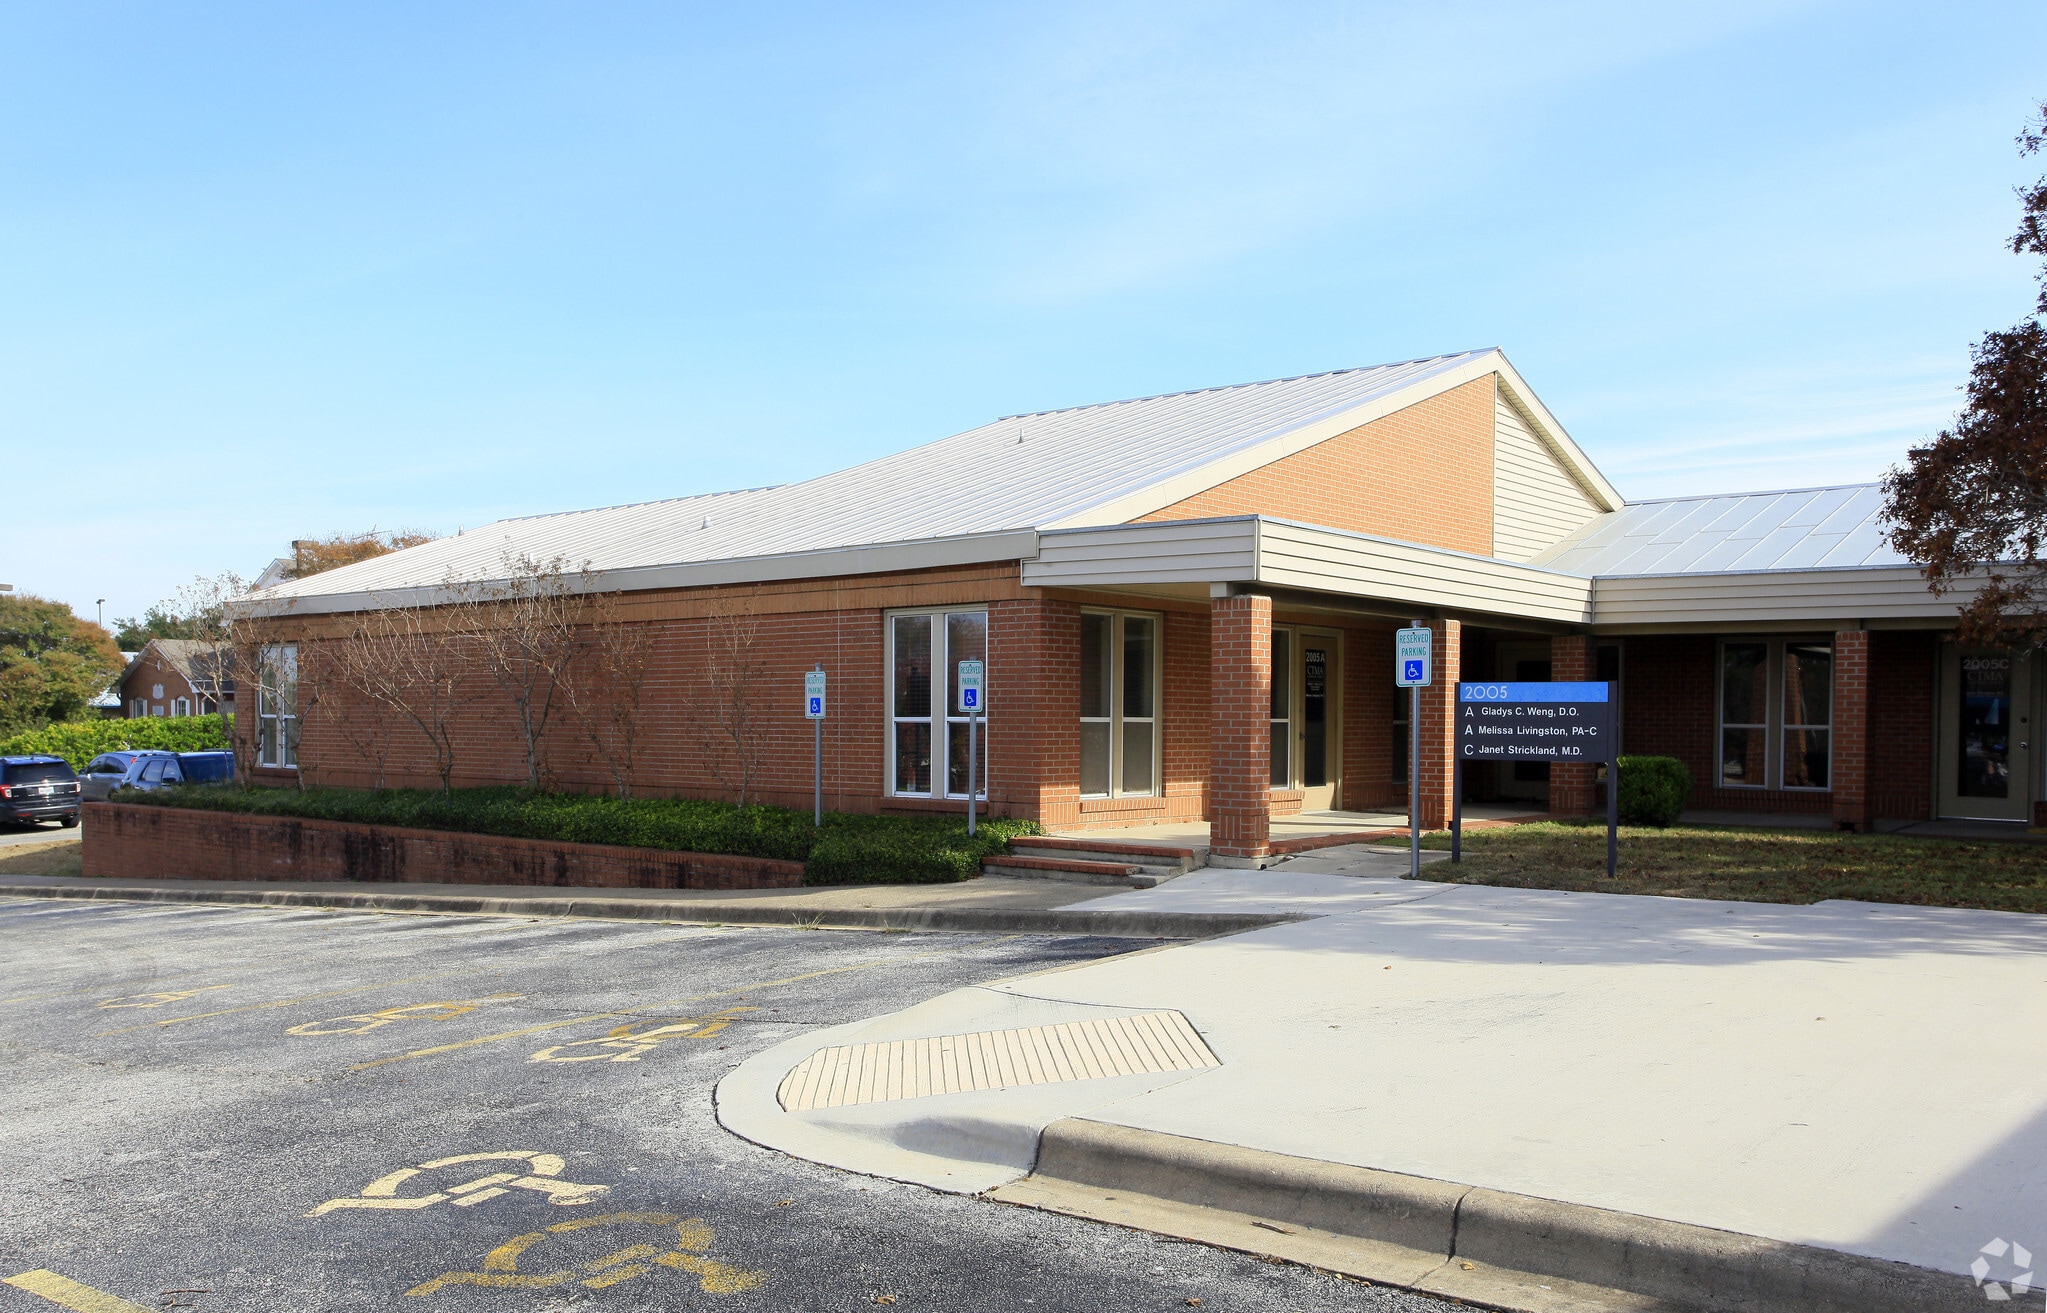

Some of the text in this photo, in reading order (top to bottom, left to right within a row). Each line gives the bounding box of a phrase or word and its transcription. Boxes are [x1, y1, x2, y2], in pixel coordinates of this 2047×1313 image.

[1399, 634, 1429, 644] RESERVED
[1402, 647, 1426, 656] PARKING
[1963, 659, 2009, 670] 2005C
[1465, 686, 1508, 699] 2005
[1465, 707, 1579, 717] A Gladys C. Weng, D.O.
[1465, 725, 1597, 737] A Melissa Livingston, PA-C
[1465, 745, 1582, 756] C Janet Strickland, M.D.
